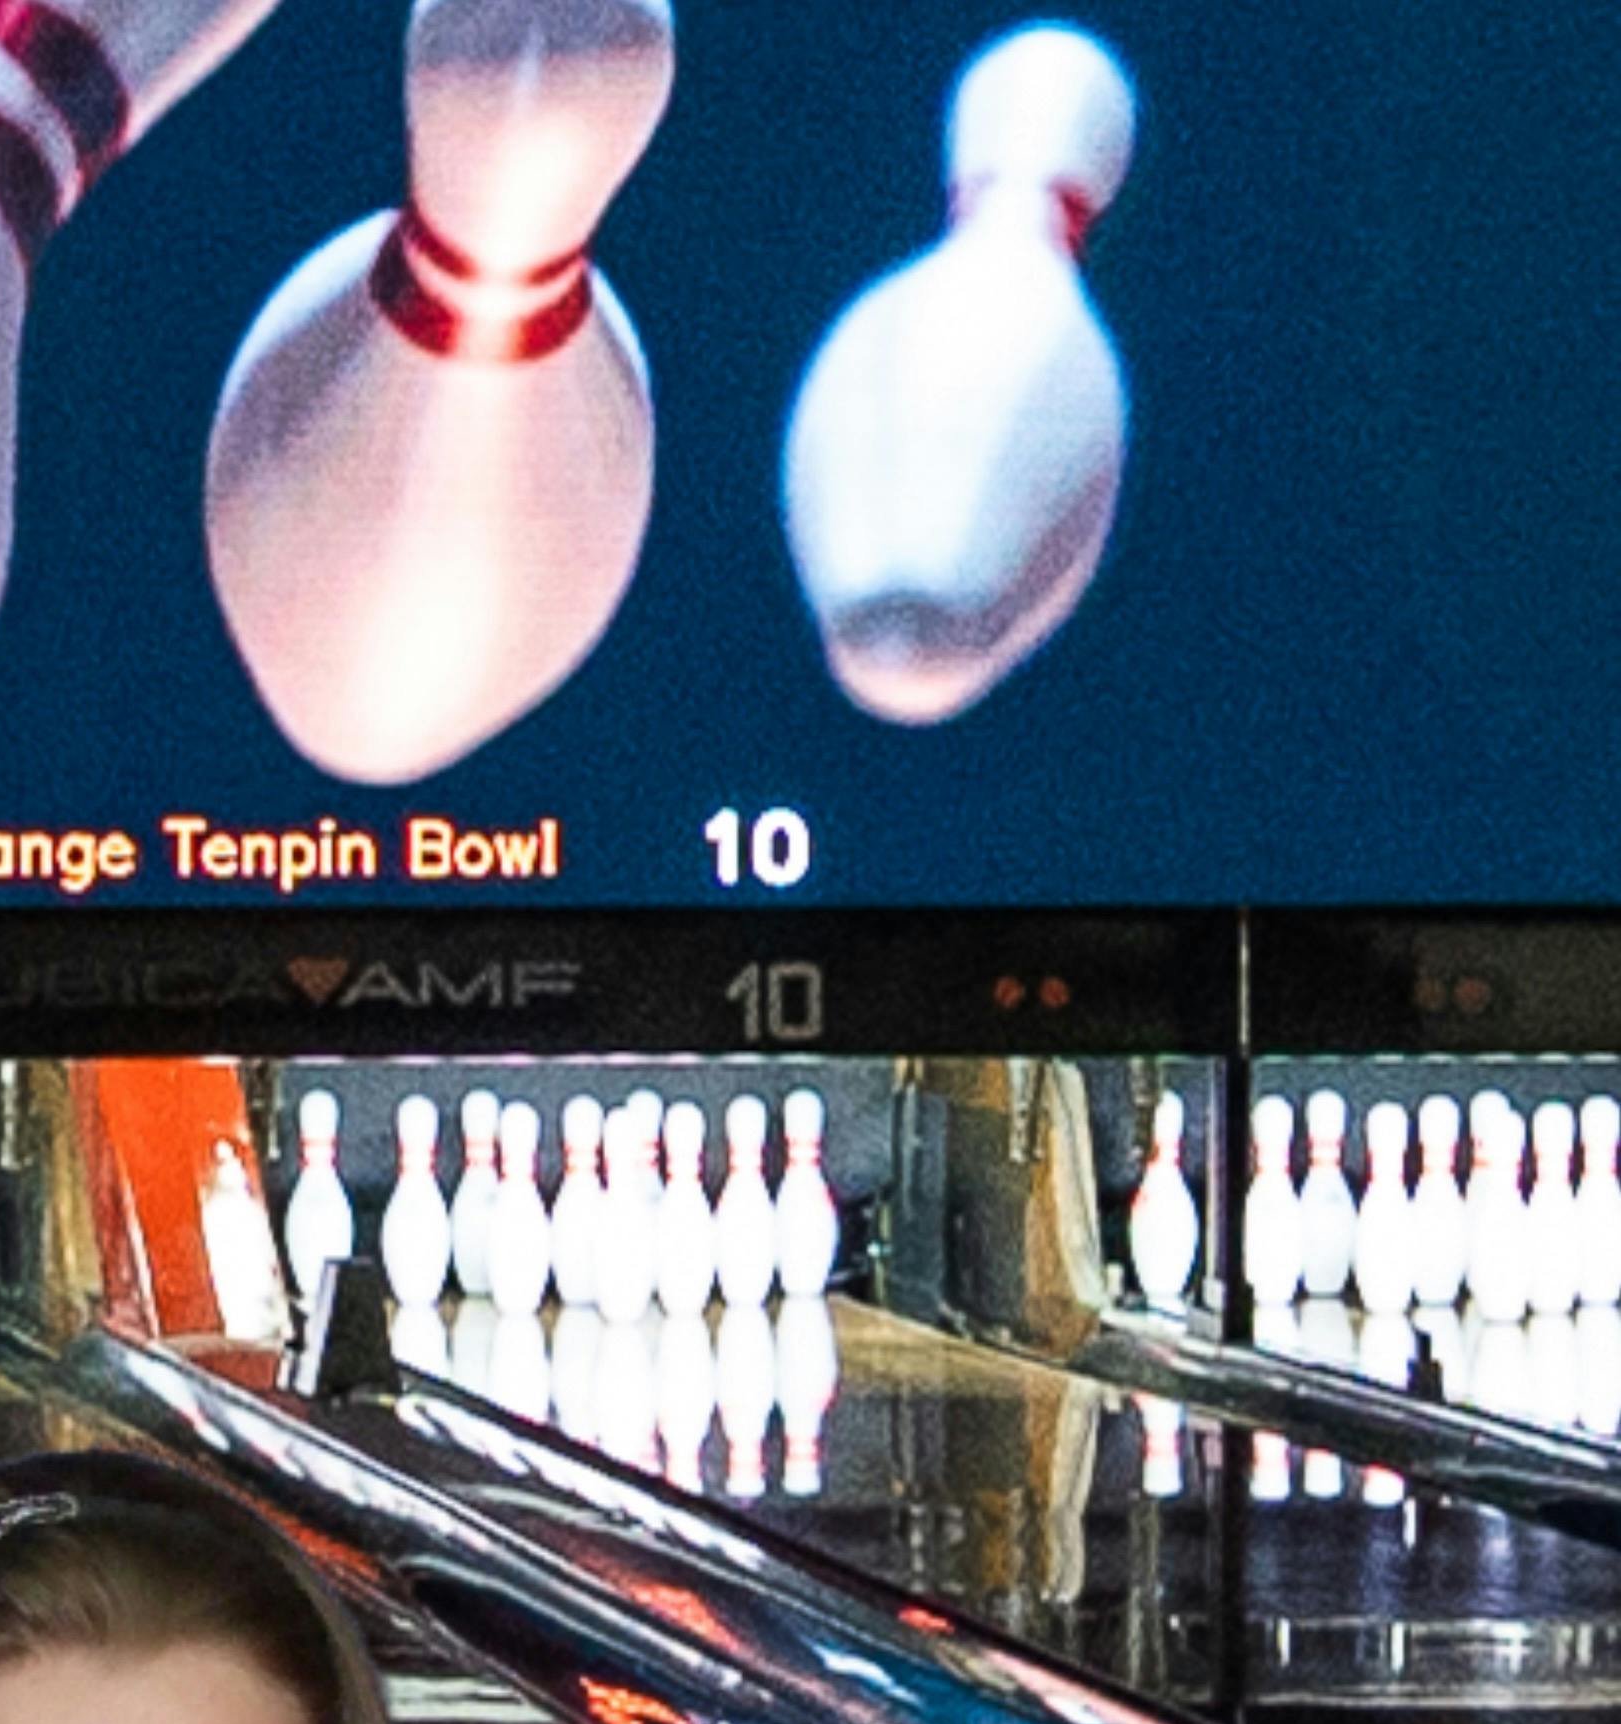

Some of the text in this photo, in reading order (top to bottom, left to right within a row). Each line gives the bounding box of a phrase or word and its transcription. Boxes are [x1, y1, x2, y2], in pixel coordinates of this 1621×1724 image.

[161, 817, 376, 892] Tenpin
[407, 817, 557, 878] Bowl
[705, 807, 810, 886] 10
[338, 957, 582, 1008] AMF
[726, 962, 822, 1040] 10
